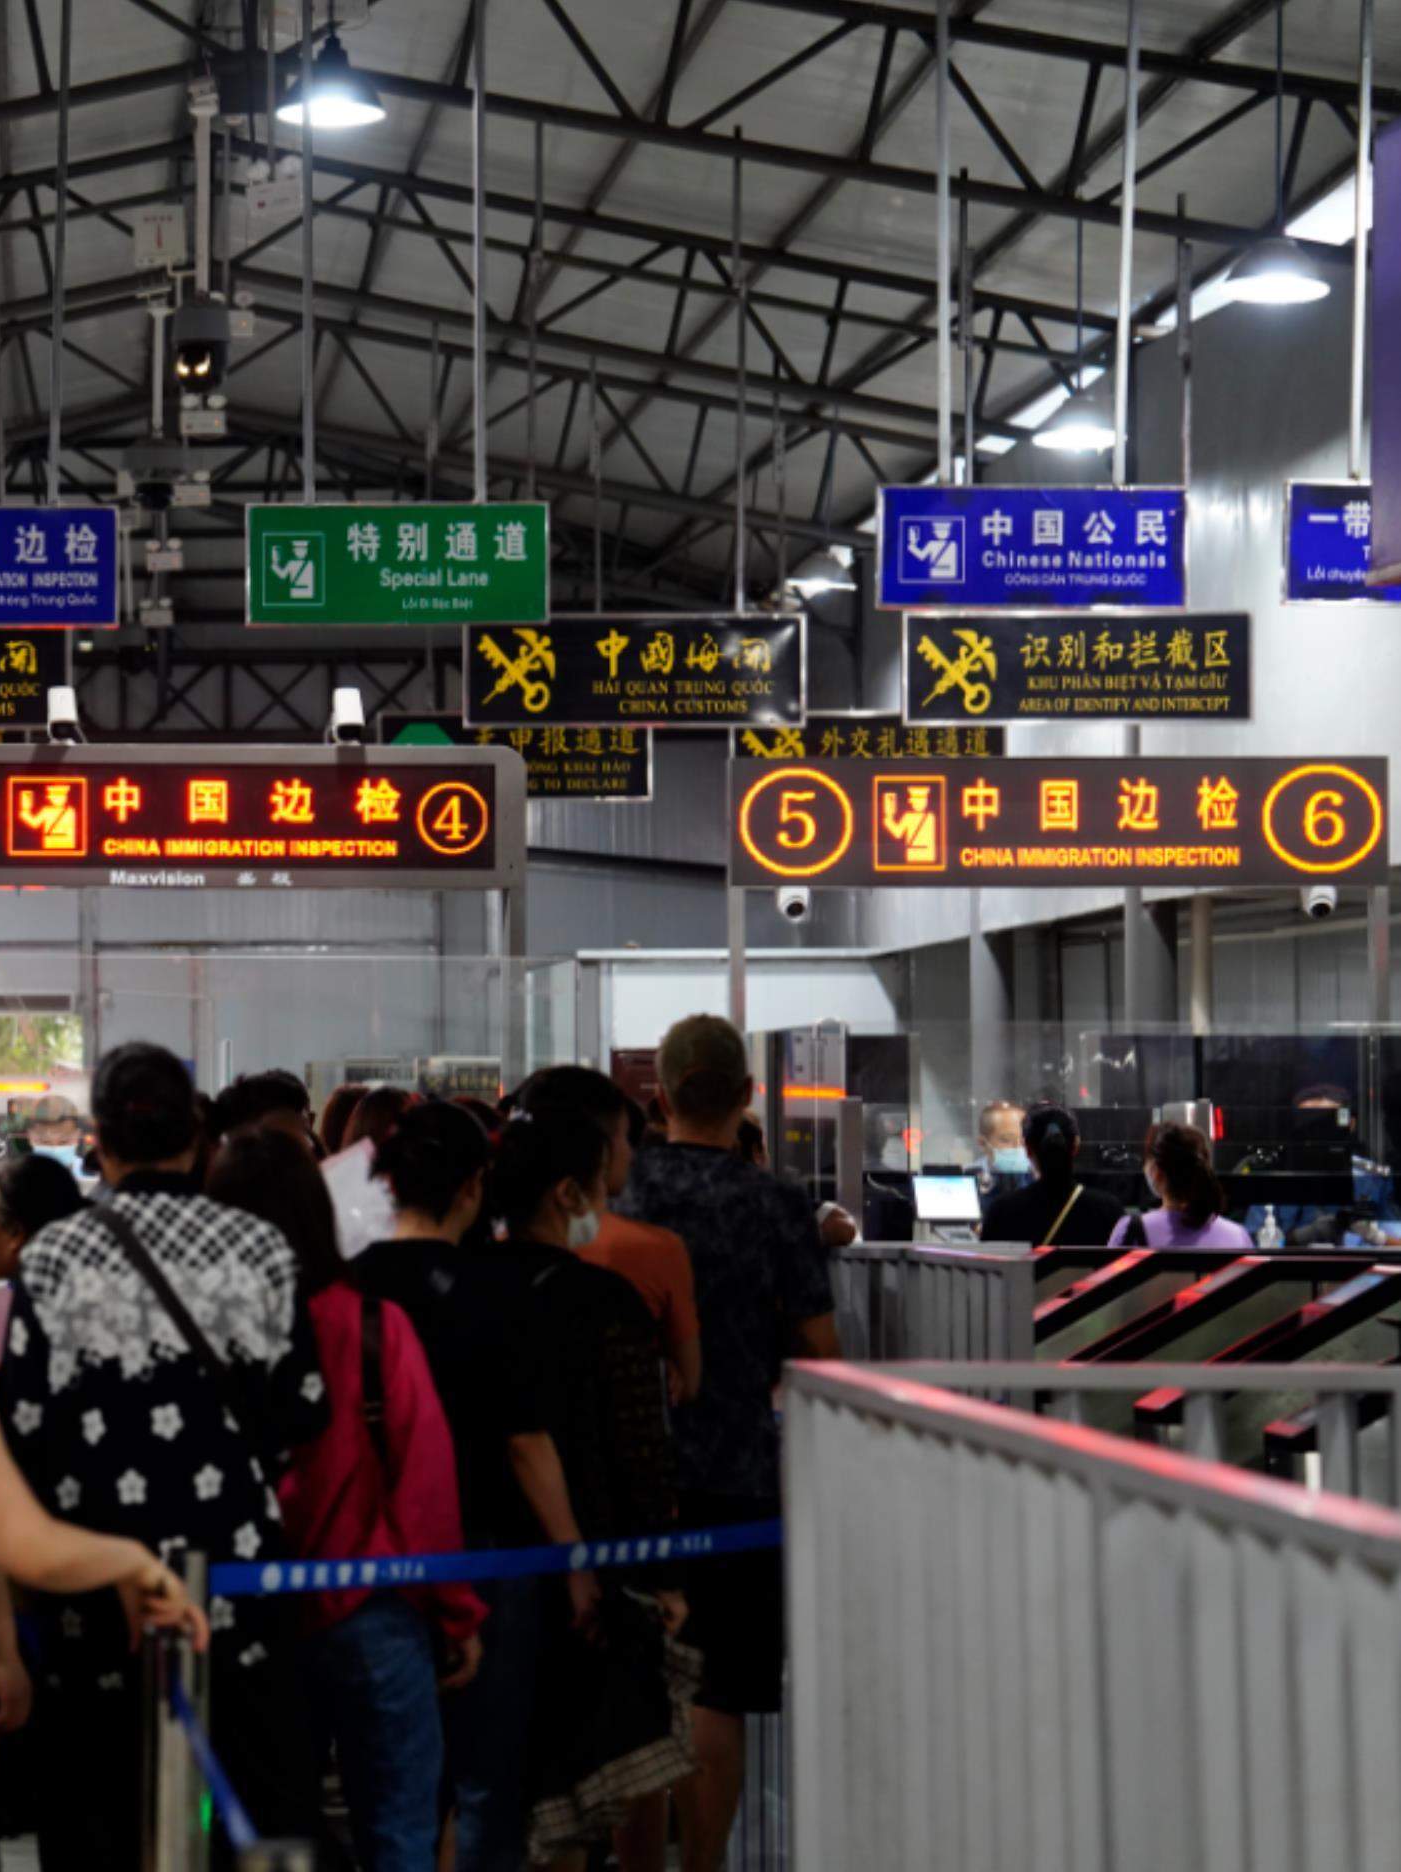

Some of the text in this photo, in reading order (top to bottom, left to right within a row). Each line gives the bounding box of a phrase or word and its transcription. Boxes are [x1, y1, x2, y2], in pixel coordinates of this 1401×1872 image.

[981, 509, 1167, 546] 中国公民
[347, 522, 527, 562] 特别通道
[982, 551, 1167, 568] Chinese Nationals
[32, 573, 98, 588] INSPECTION
[380, 567, 489, 591] Special Lane
[1019, 628, 1231, 671] 识别和拦截区
[625, 680, 668, 695] QUAN
[674, 680, 726, 695] TRUNG
[1027, 675, 1058, 690] KHU
[619, 700, 748, 714] CHINA CUSTOMS
[1018, 697, 1230, 712] AREA OF IDENTIFY AND INTERCEPT
[104, 777, 401, 823] 中国边检
[961, 775, 1239, 832] 中国边检
[103, 838, 398, 857] CHINA IMMIGRATION INSPECTION
[960, 847, 1240, 867] CHINA IMMIGRATION INSPECTION
[110, 870, 204, 886] Maxvision
